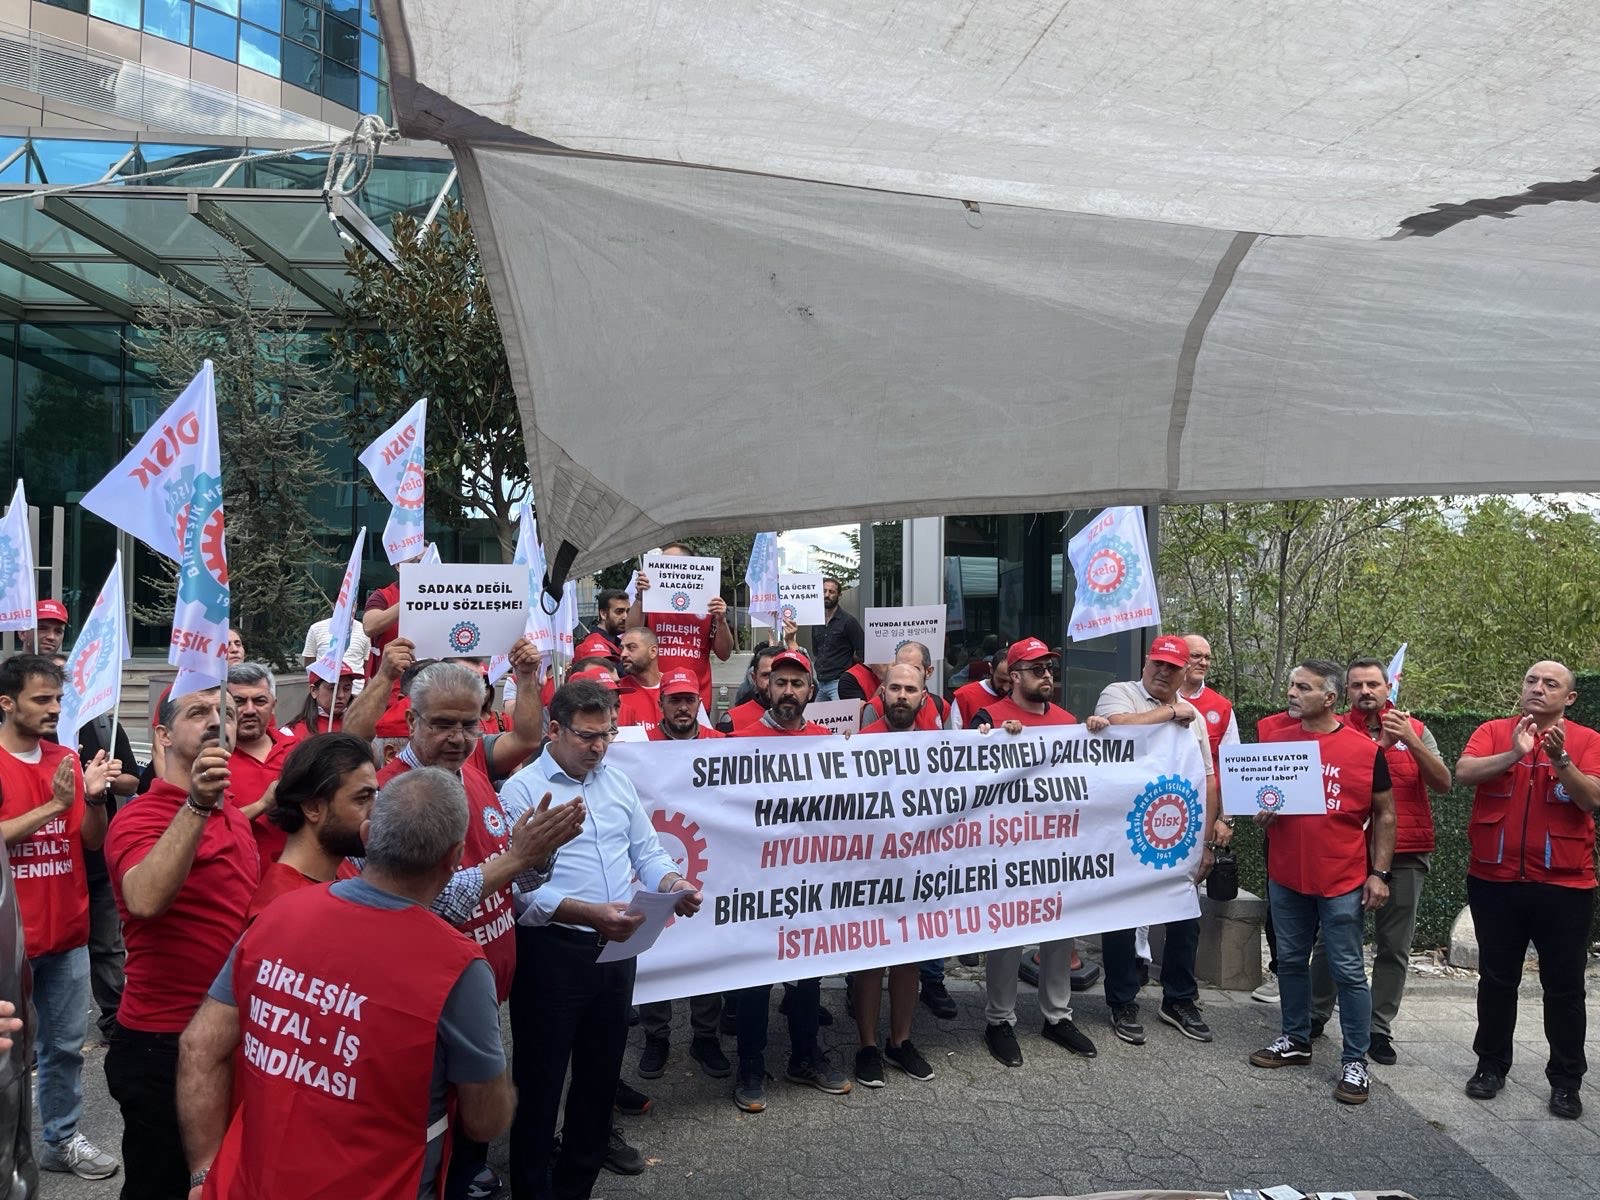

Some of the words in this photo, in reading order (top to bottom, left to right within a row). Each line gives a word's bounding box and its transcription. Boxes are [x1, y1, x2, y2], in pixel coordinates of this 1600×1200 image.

[648, 562, 688, 570] HAKKIMIZ
[689, 564, 714, 572] OLANI
[418, 584, 472, 594] SADAKA
[476, 581, 513, 594] DEĞİL
[659, 581, 704, 590] ALACAĞIZ!
[406, 601, 449, 611] TOPLU
[452, 598, 523, 612] SÖZLEŞME!
[656, 622, 700, 636] BİRLEŞİK
[902, 619, 939, 627] ELEVATOR
[171, 628, 212, 654] EŞİK
[658, 646, 701, 659] ENDİKASI
[813, 714, 854, 725] YAŞAMAK
[692, 748, 813, 788] SENDİKALI
[817, 751, 848, 780] VE
[851, 747, 921, 778] TOPLU
[927, 736, 1047, 774] SÖZLEŞMELİ
[1050, 739, 1135, 767] ÇALIŞMA
[1225, 756, 1260, 764] HYUNDAI
[1262, 754, 1309, 762] ELEVATOR
[1240, 765, 1272, 773] demand
[1274, 764, 1291, 772] fair
[1292, 765, 1310, 773] pay
[1165, 782, 1193, 799] İŞÇİLERİ
[1327, 780, 1341, 797] İŞ
[755, 791, 896, 827] HAKKIMIZA
[902, 786, 967, 817] SAYGI
[972, 776, 1089, 809] DUYULSUN!
[1140, 786, 1163, 810] METAL
[1153, 813, 1180, 828] DİSK
[760, 833, 874, 869] HYUNDAI
[880, 818, 982, 860] ASANSÖR
[989, 809, 1080, 847] İŞÇİLERİ
[1133, 812, 1148, 852] BİRLEŞİK
[1156, 851, 1172, 860] 1947
[715, 879, 824, 926] BİRLEŞİK
[830, 877, 905, 909] METAL
[912, 858, 998, 903] İŞÇİLERİ
[1005, 851, 1115, 889] SENDİKASI
[777, 918, 890, 961] İSTANBUL
[897, 915, 909, 943] 1
[987, 890, 1063, 934] ŞUBESİ
[256, 958, 369, 1022] BİRLEŞİK
[250, 994, 312, 1045] METAL
[333, 1026, 361, 1068] İŞ
[244, 1031, 357, 1100] SENDİKASI
